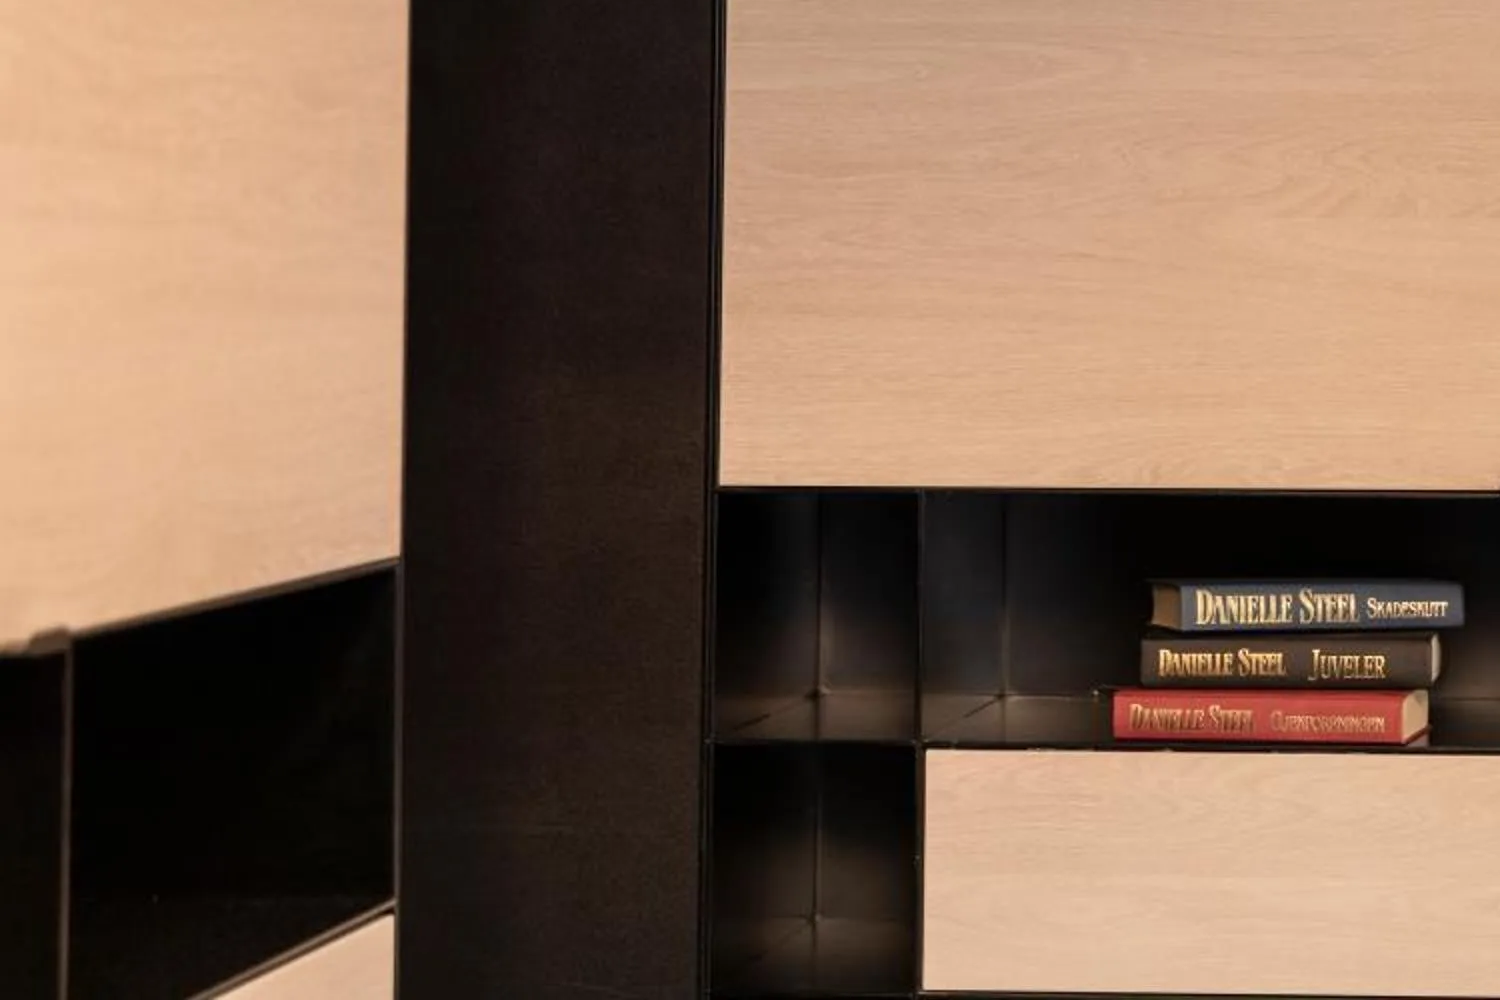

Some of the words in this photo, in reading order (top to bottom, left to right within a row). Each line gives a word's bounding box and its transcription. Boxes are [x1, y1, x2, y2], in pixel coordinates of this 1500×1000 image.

[1195, 588, 1293, 626] DANIELLE
[1298, 587, 1360, 624] STEEL
[1158, 648, 1233, 677] DANIELLE
[1237, 648, 1287, 676] STEEL
[1307, 648, 1387, 682] JUVELER
